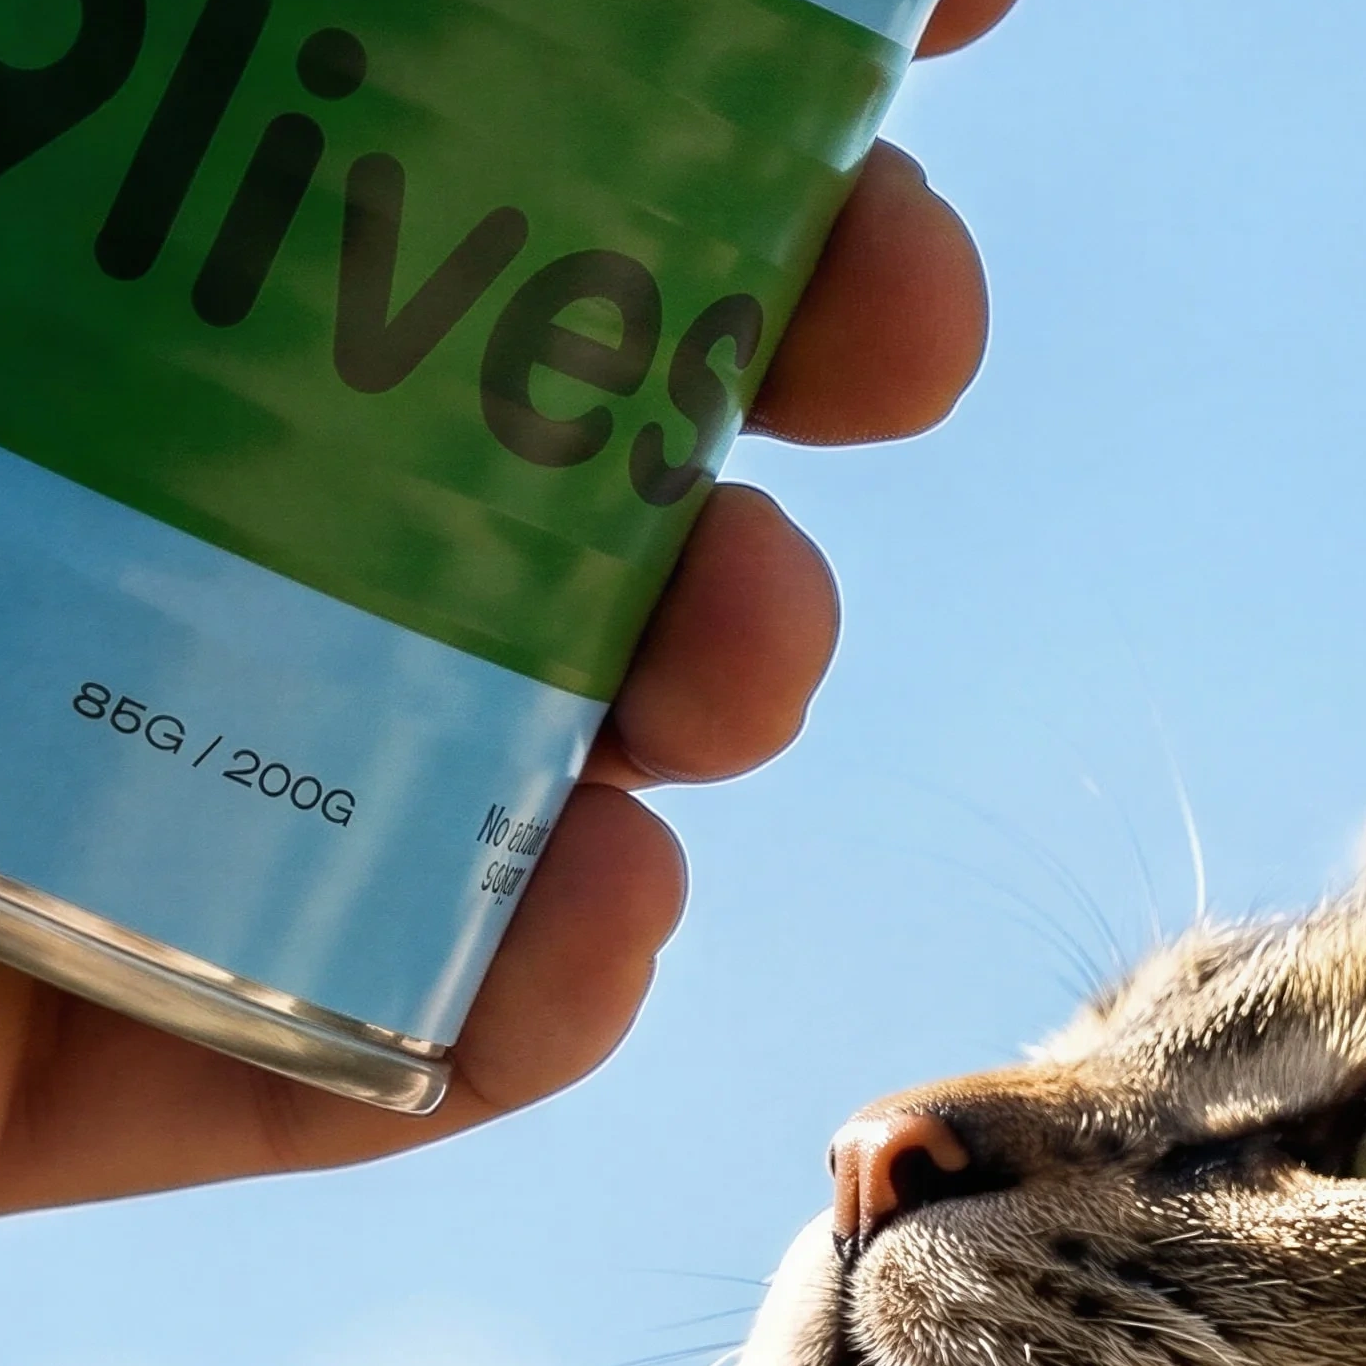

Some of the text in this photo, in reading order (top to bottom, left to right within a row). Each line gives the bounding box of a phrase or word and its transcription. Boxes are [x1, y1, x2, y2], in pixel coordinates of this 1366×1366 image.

[72, 682, 186, 755] 85G
[222, 749, 356, 828] 200G
[476, 803, 510, 847] No
